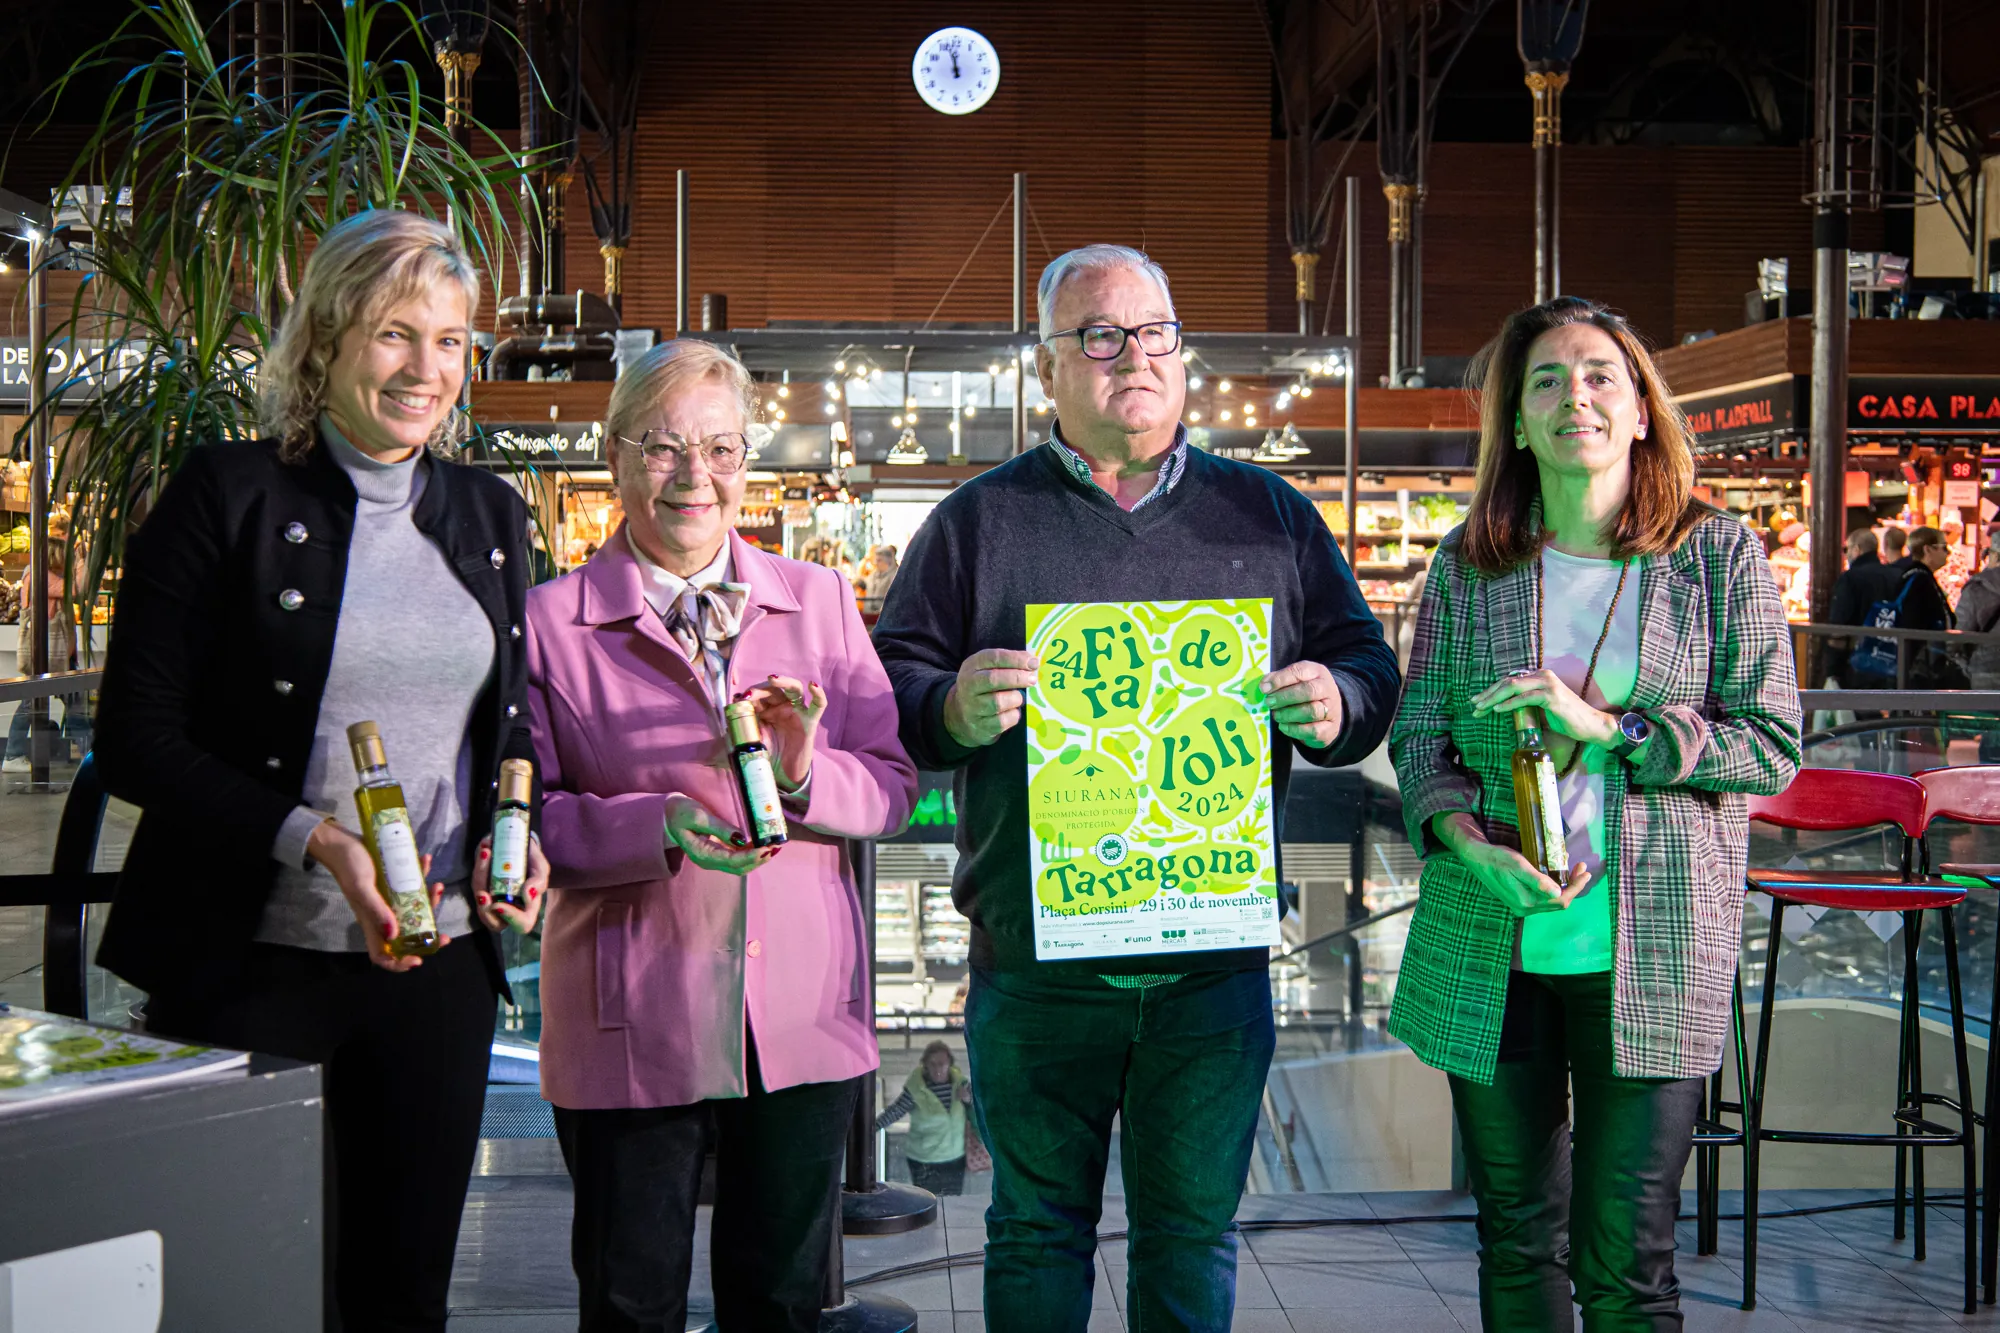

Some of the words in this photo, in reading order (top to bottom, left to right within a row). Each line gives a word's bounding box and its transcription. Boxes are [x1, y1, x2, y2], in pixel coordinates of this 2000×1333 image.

[3, 347, 29, 365] DE
[3, 367, 30, 385] LA
[1857, 395, 1939, 419] CASA
[1952, 463, 1971, 478] 98
[1179, 629, 1231, 668] de
[1046, 639, 1083, 678] 24
[1043, 787, 1136, 804] SIURANA
[1176, 782, 1244, 817] 2024
[1102, 807, 1146, 816] D'ORIGEN
[1066, 820, 1116, 830] PROTEGIDA
[1046, 849, 1257, 903] Tarragona
[1040, 905, 1076, 920] Plaça
[1079, 902, 1128, 916] Corsini
[1139, 898, 1157, 912] 29
[1160, 899, 1165, 911] i
[1167, 897, 1186, 910] 30
[1189, 896, 1205, 909] de
[1208, 893, 1272, 908] novembre
[1161, 937, 1187, 945] MERCATS
